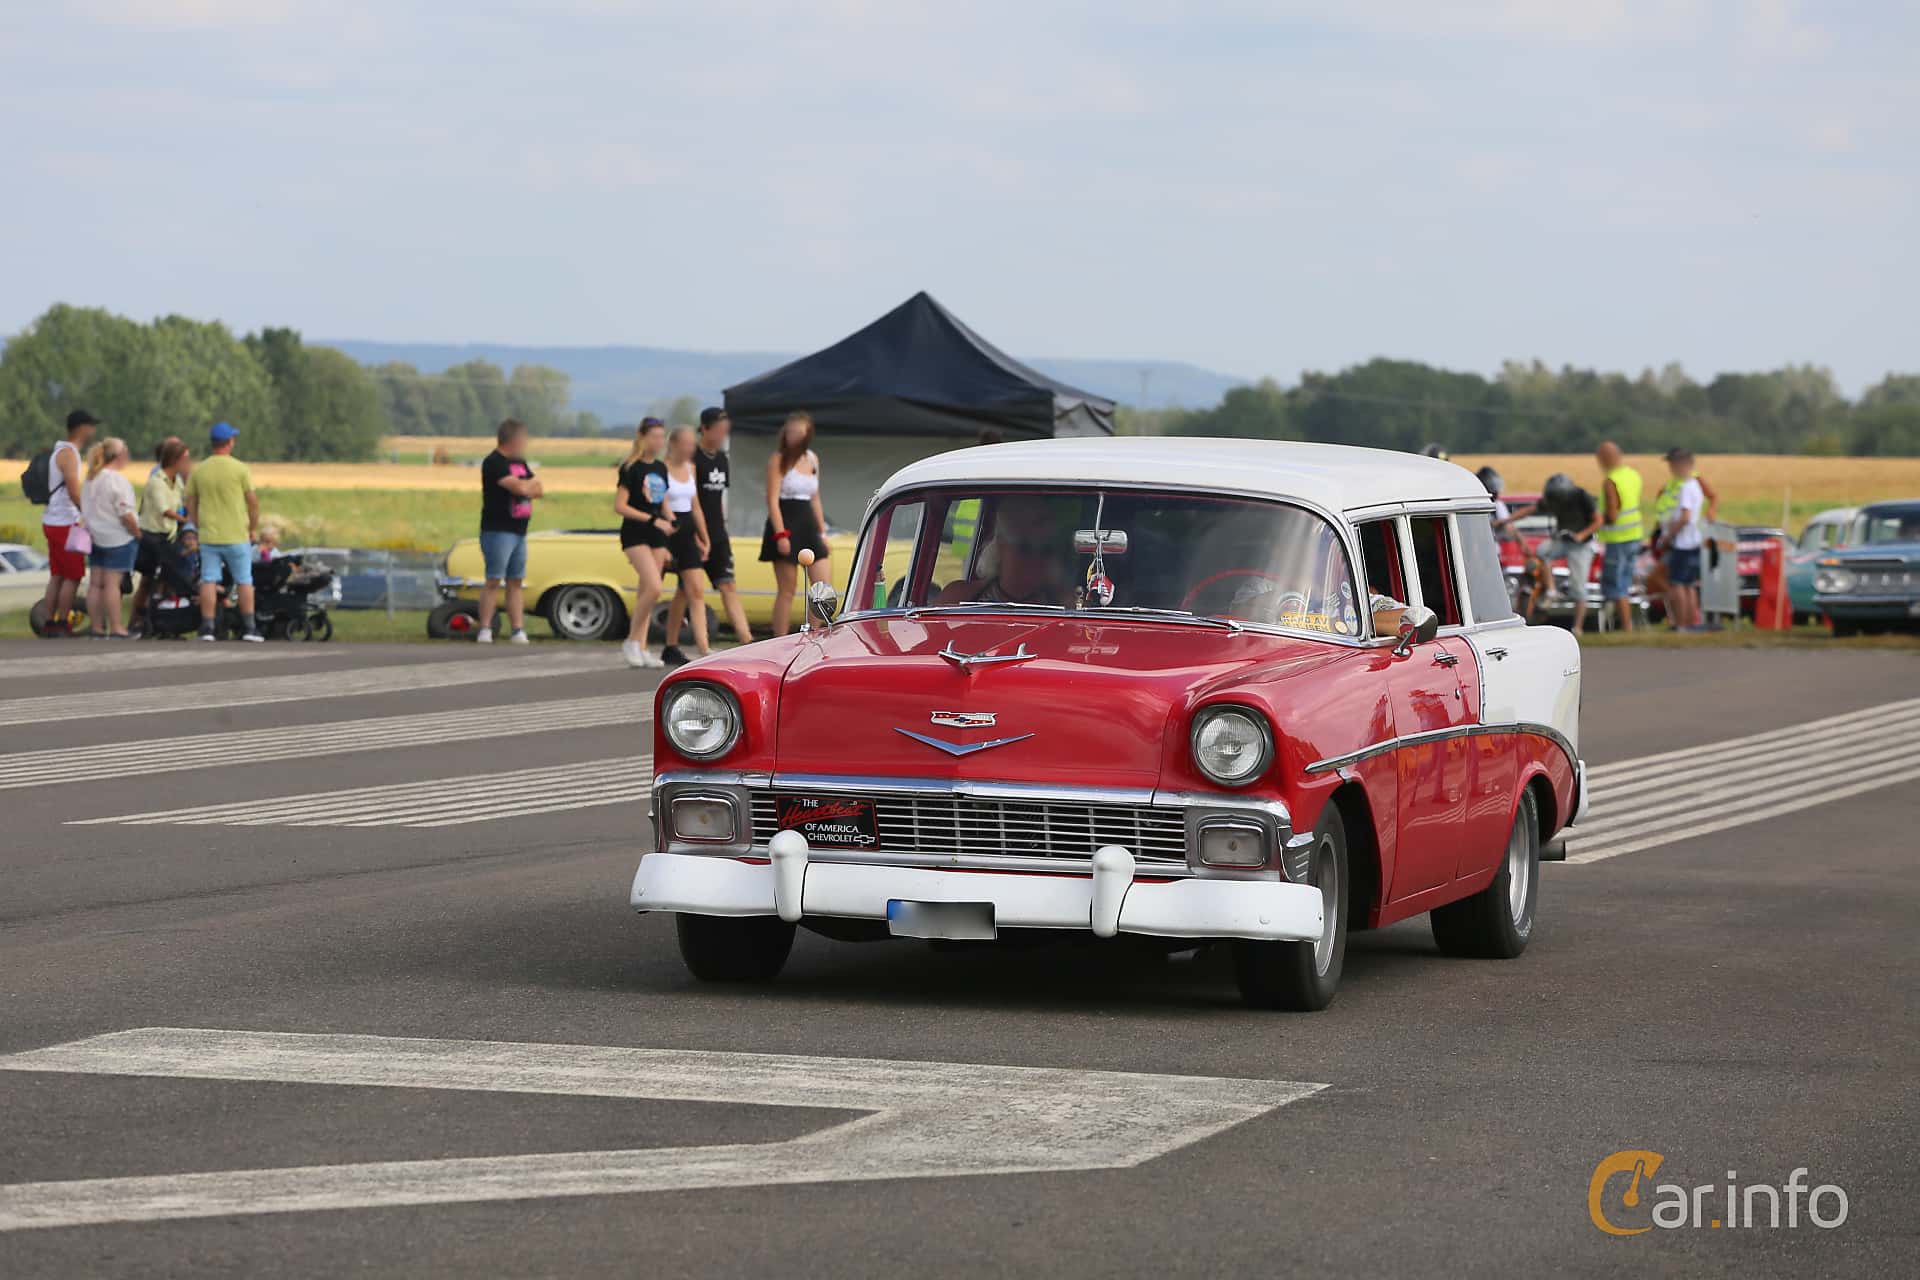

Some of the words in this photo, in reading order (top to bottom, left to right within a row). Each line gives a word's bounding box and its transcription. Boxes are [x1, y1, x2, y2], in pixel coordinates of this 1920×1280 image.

[801, 798, 819, 808] THE
[804, 823, 817, 831] OF
[818, 823, 860, 833] AMERICA
[807, 832, 853, 843] CHEVROLET
